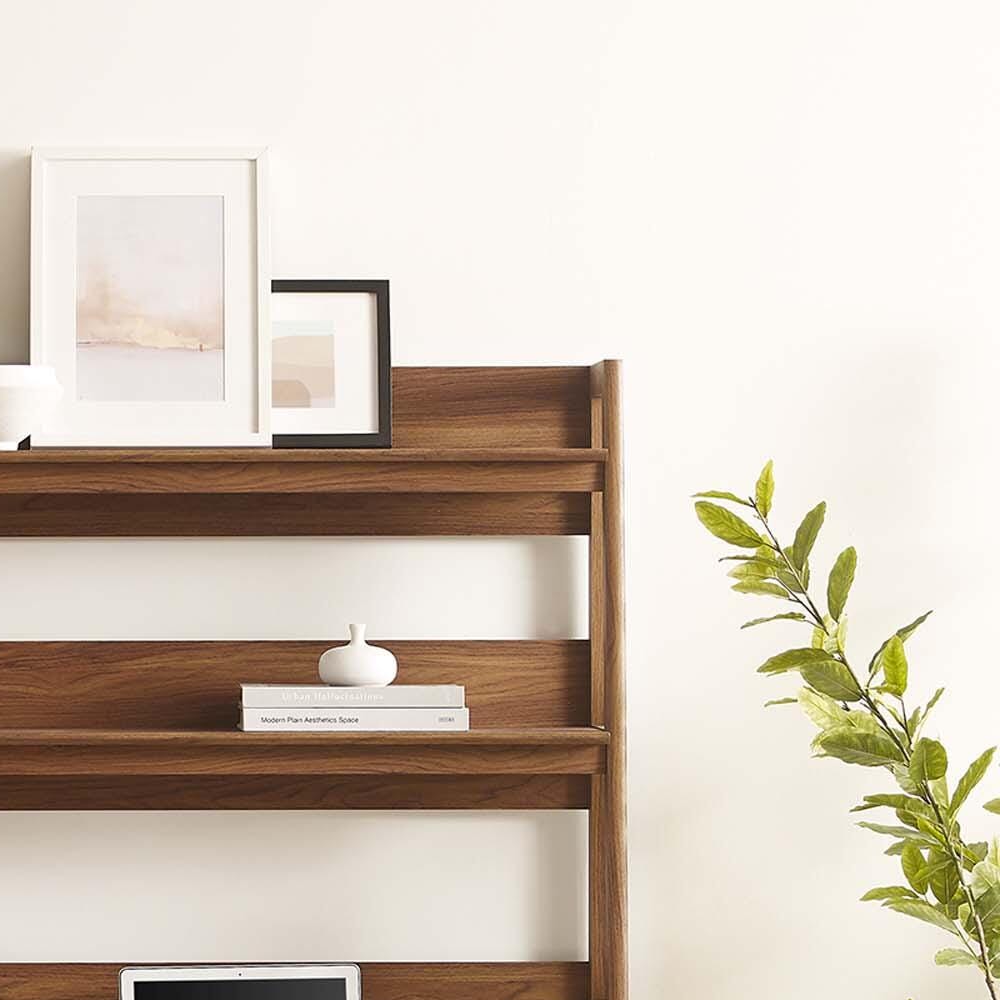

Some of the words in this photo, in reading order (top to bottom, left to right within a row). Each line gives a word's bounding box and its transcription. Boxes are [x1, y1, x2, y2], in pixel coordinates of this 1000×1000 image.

[261, 716, 286, 724] Modern
[304, 716, 338, 724] Aesthetics
[338, 716, 360, 725] Space
